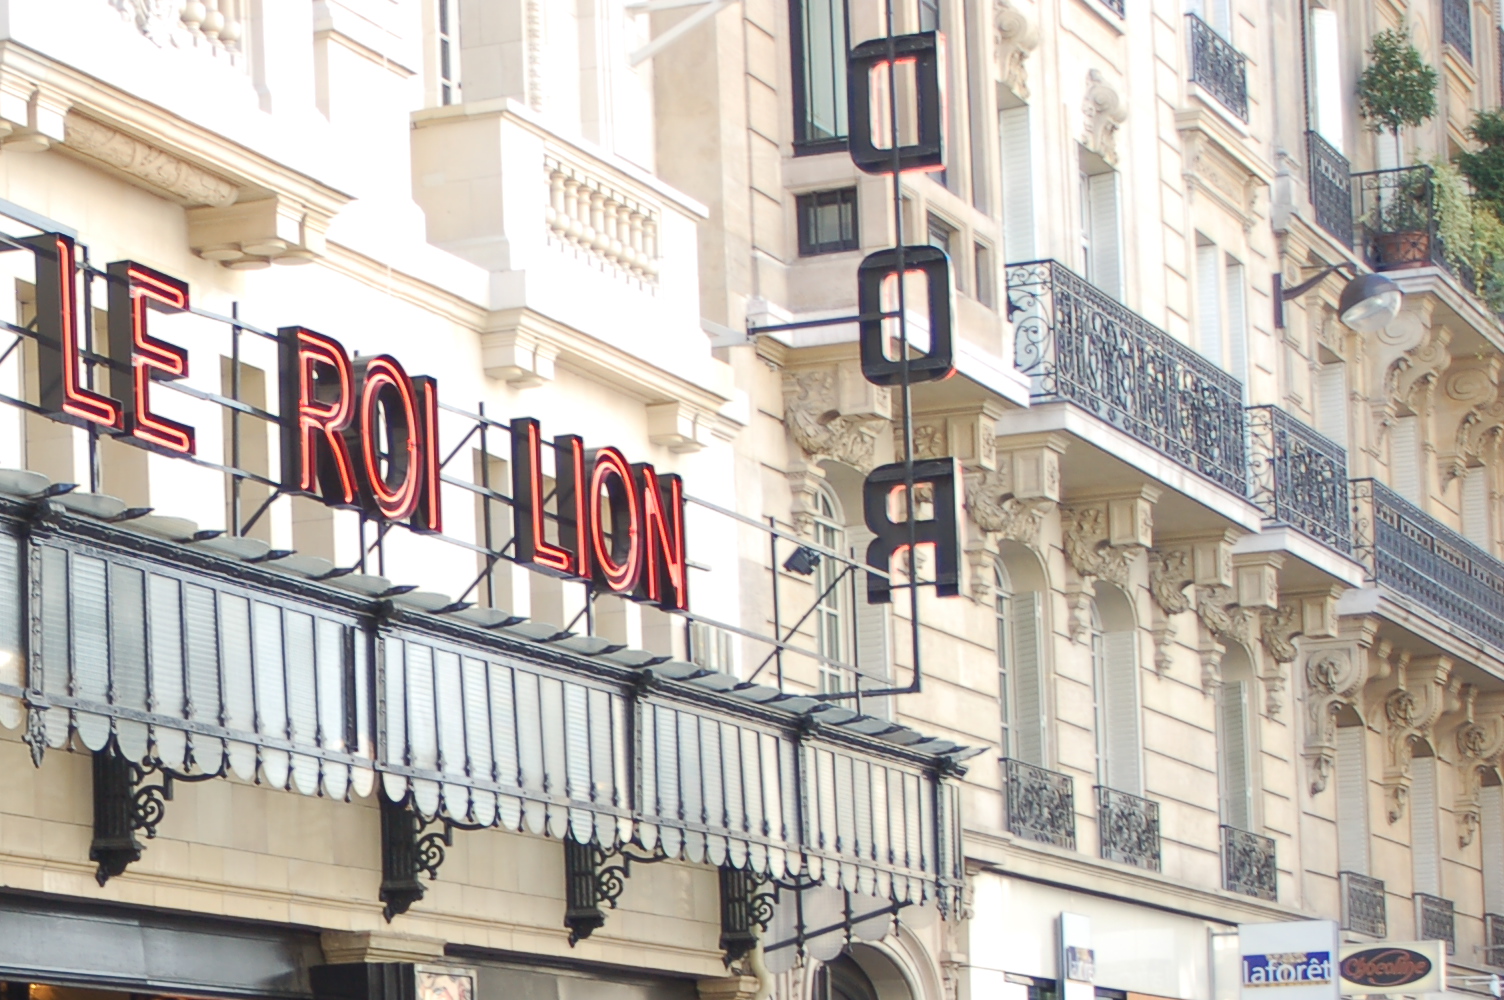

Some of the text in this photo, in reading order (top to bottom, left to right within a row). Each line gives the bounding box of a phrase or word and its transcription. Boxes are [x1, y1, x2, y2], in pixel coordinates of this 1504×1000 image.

[38, 232, 689, 612] LE ROI LION
[1243, 956, 1332, 985] laforêt
